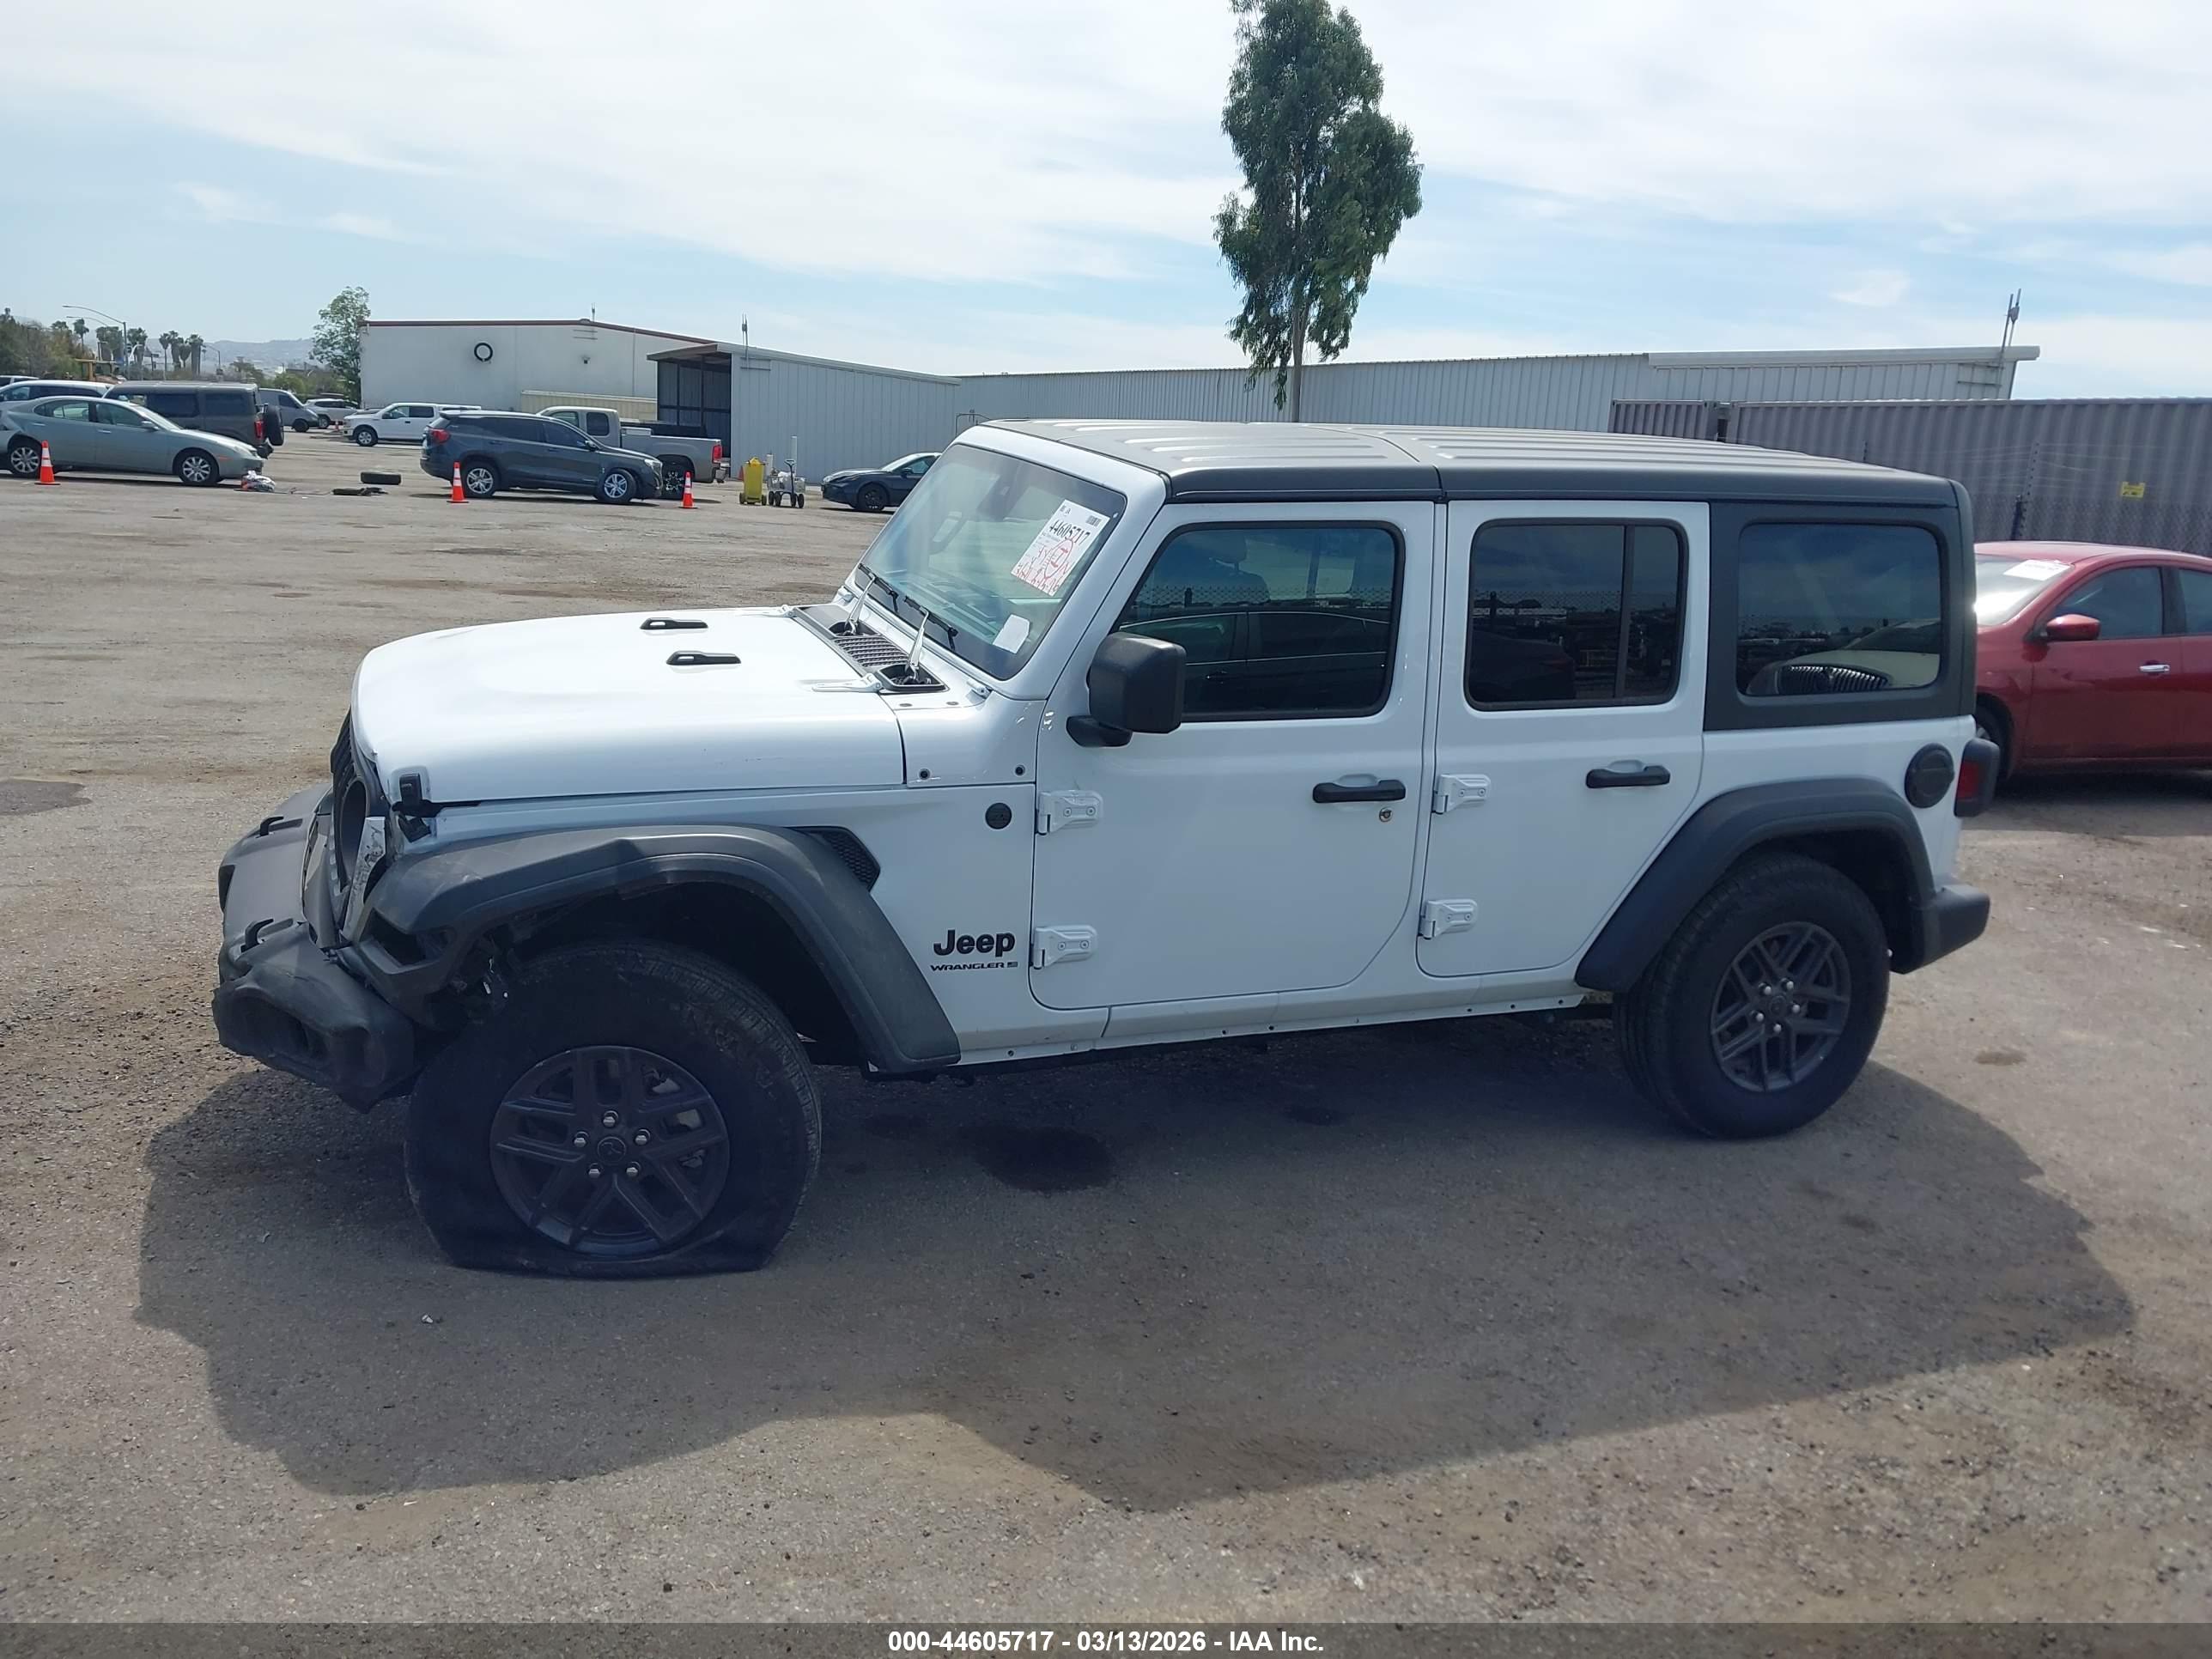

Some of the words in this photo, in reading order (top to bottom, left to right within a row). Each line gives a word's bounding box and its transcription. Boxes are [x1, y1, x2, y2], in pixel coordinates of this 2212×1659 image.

[1049, 520, 1091, 546] 44605717
[933, 929, 1016, 957] Jeep
[930, 962, 1005, 971] WRANGLER
